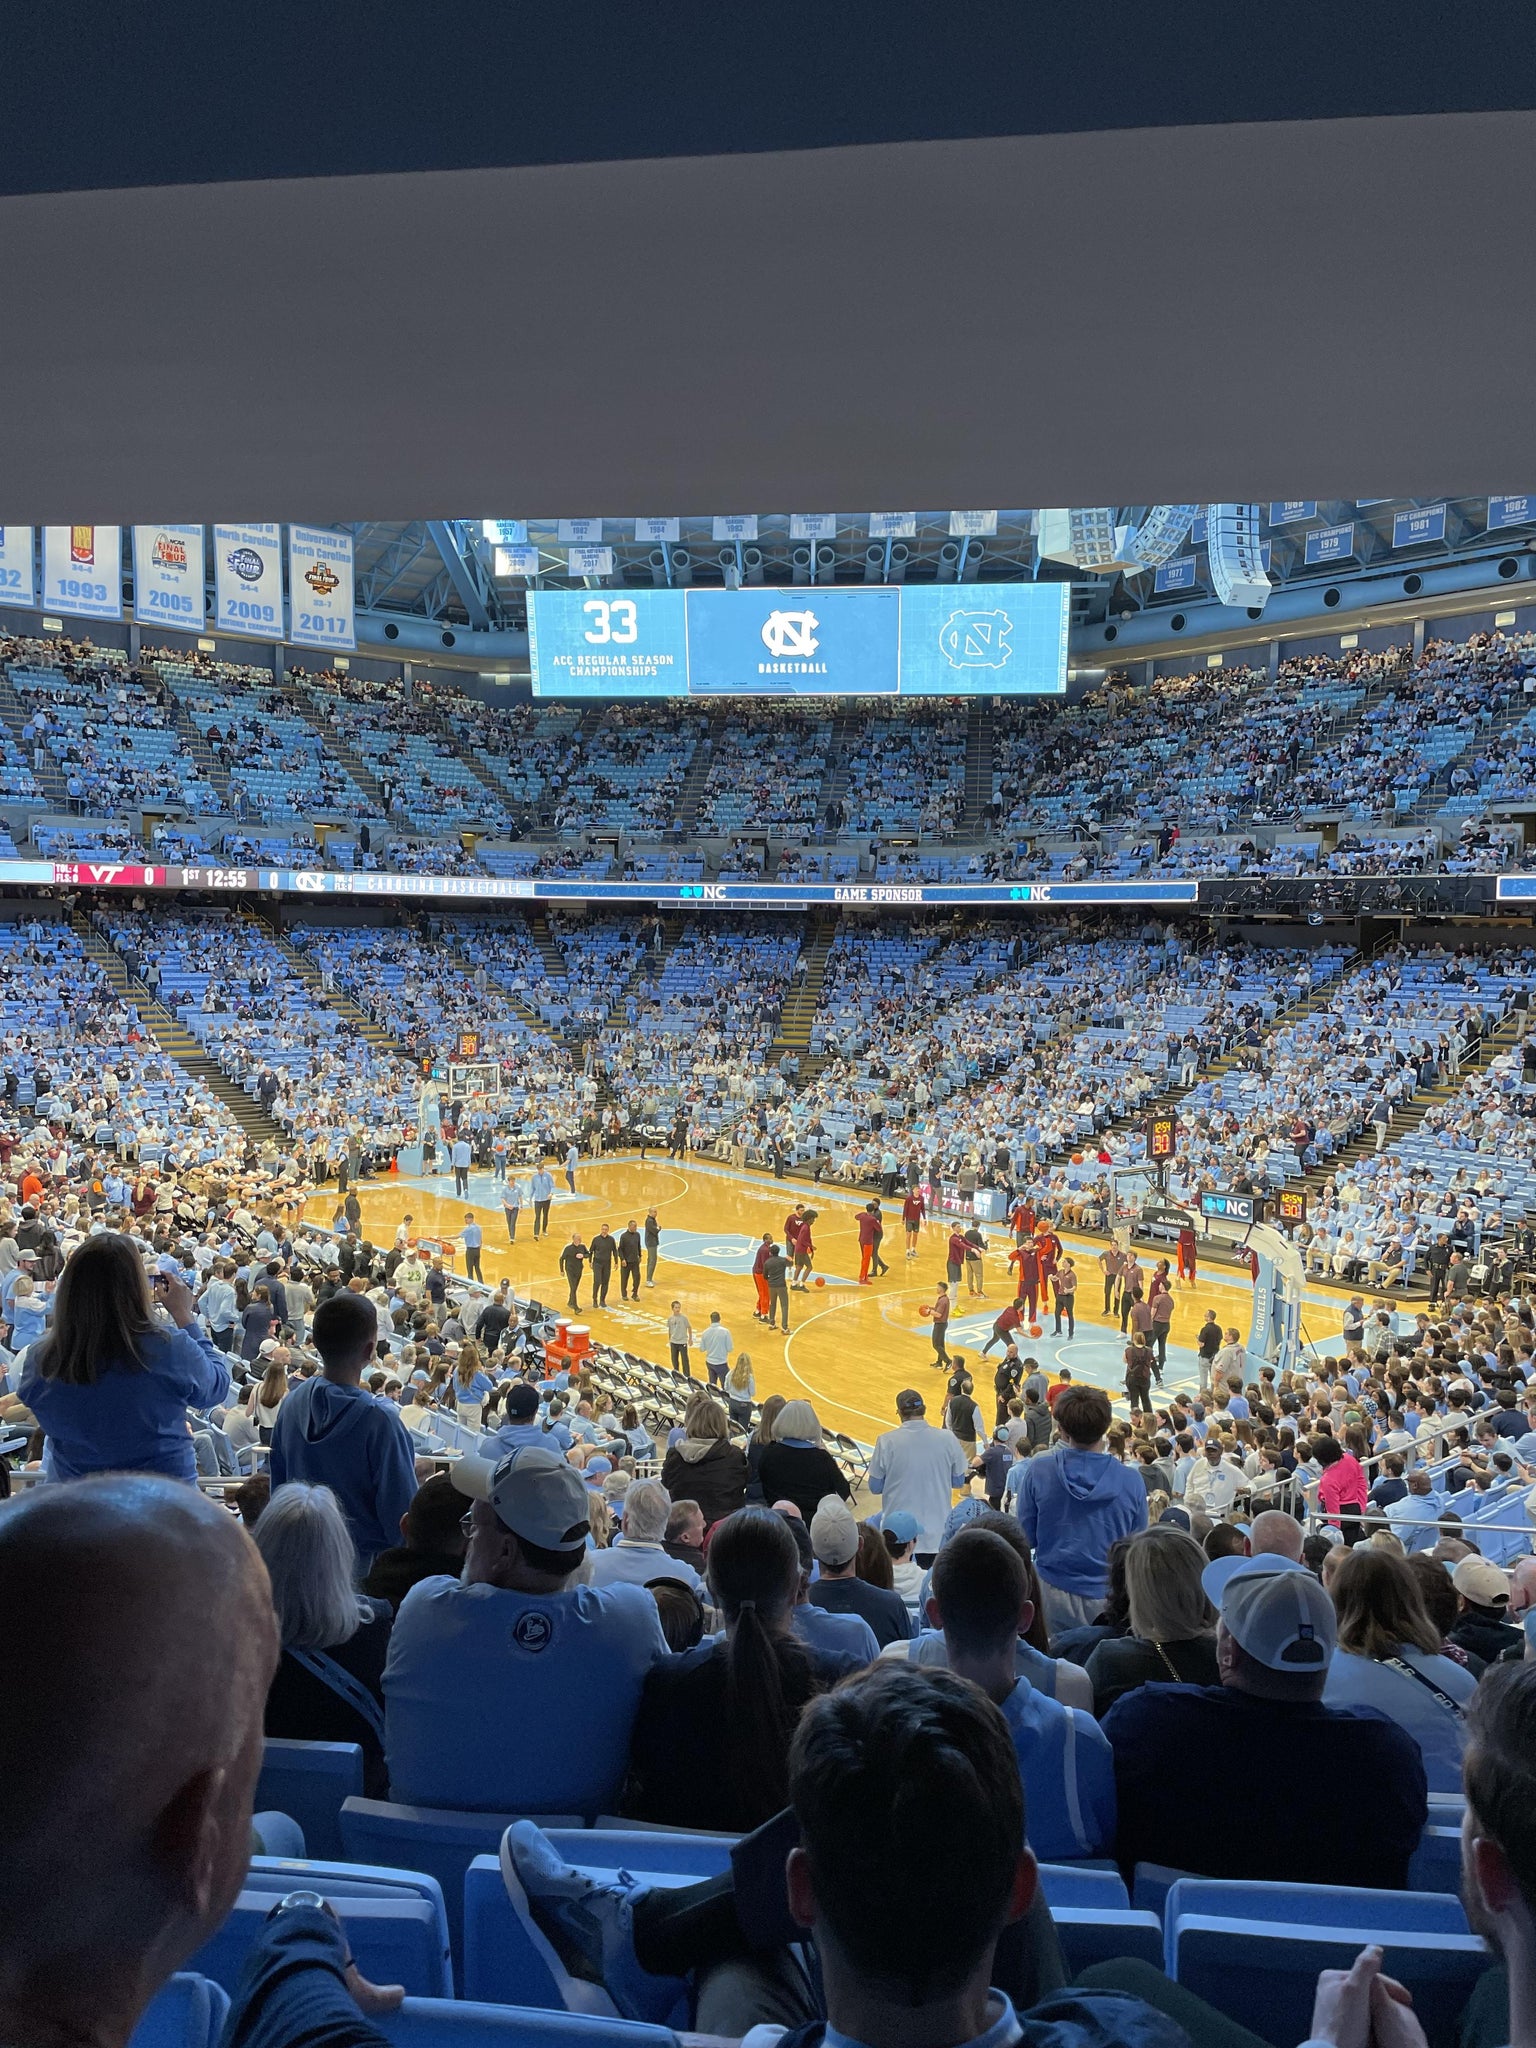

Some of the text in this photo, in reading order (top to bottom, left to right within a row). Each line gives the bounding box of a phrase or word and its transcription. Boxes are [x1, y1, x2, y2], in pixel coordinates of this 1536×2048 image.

[1410, 519, 1430, 531] 1981
[295, 530, 337, 548] University
[1320, 538, 1338, 549] 1979
[157, 543, 185, 554] FINAL
[317, 548, 351, 563] Carolina
[233, 558, 260, 575] FOUR
[1168, 568, 1182, 578] 1977
[57, 579, 107, 601] 1993
[149, 589, 193, 612] 2005
[227, 600, 274, 622] 2009
[300, 613, 346, 633] 2017
[583, 600, 638, 643] 33
[553, 655, 673, 666] ACC REGULAR SEASON
[570, 666, 657, 676] CHAMPIONSHIPS
[758, 662, 828, 674] BASKETBALL
[56, 864, 78, 874] TOL: 4
[144, 867, 154, 885] 0
[56, 873, 72, 882] FLS:
[181, 868, 247, 888] 1ST 12:55
[269, 871, 279, 889] 0
[367, 878, 521, 895] CAROLINA BASKETBALL
[703, 886, 727, 899] NC
[834, 888, 923, 901] GAME SPONSOR
[1030, 887, 1051, 901] NC
[462, 1042, 475, 1055] 30
[1154, 1134, 1169, 1155] 30
[1281, 1193, 1303, 1204] 12:54
[1226, 1200, 1249, 1217] NC
[1284, 1204, 1298, 1217] 30
[407, 1270, 421, 1281] 23
[1255, 1287, 1267, 1340] @GOHEELS
[1433, 1692, 1454, 1710] GO
